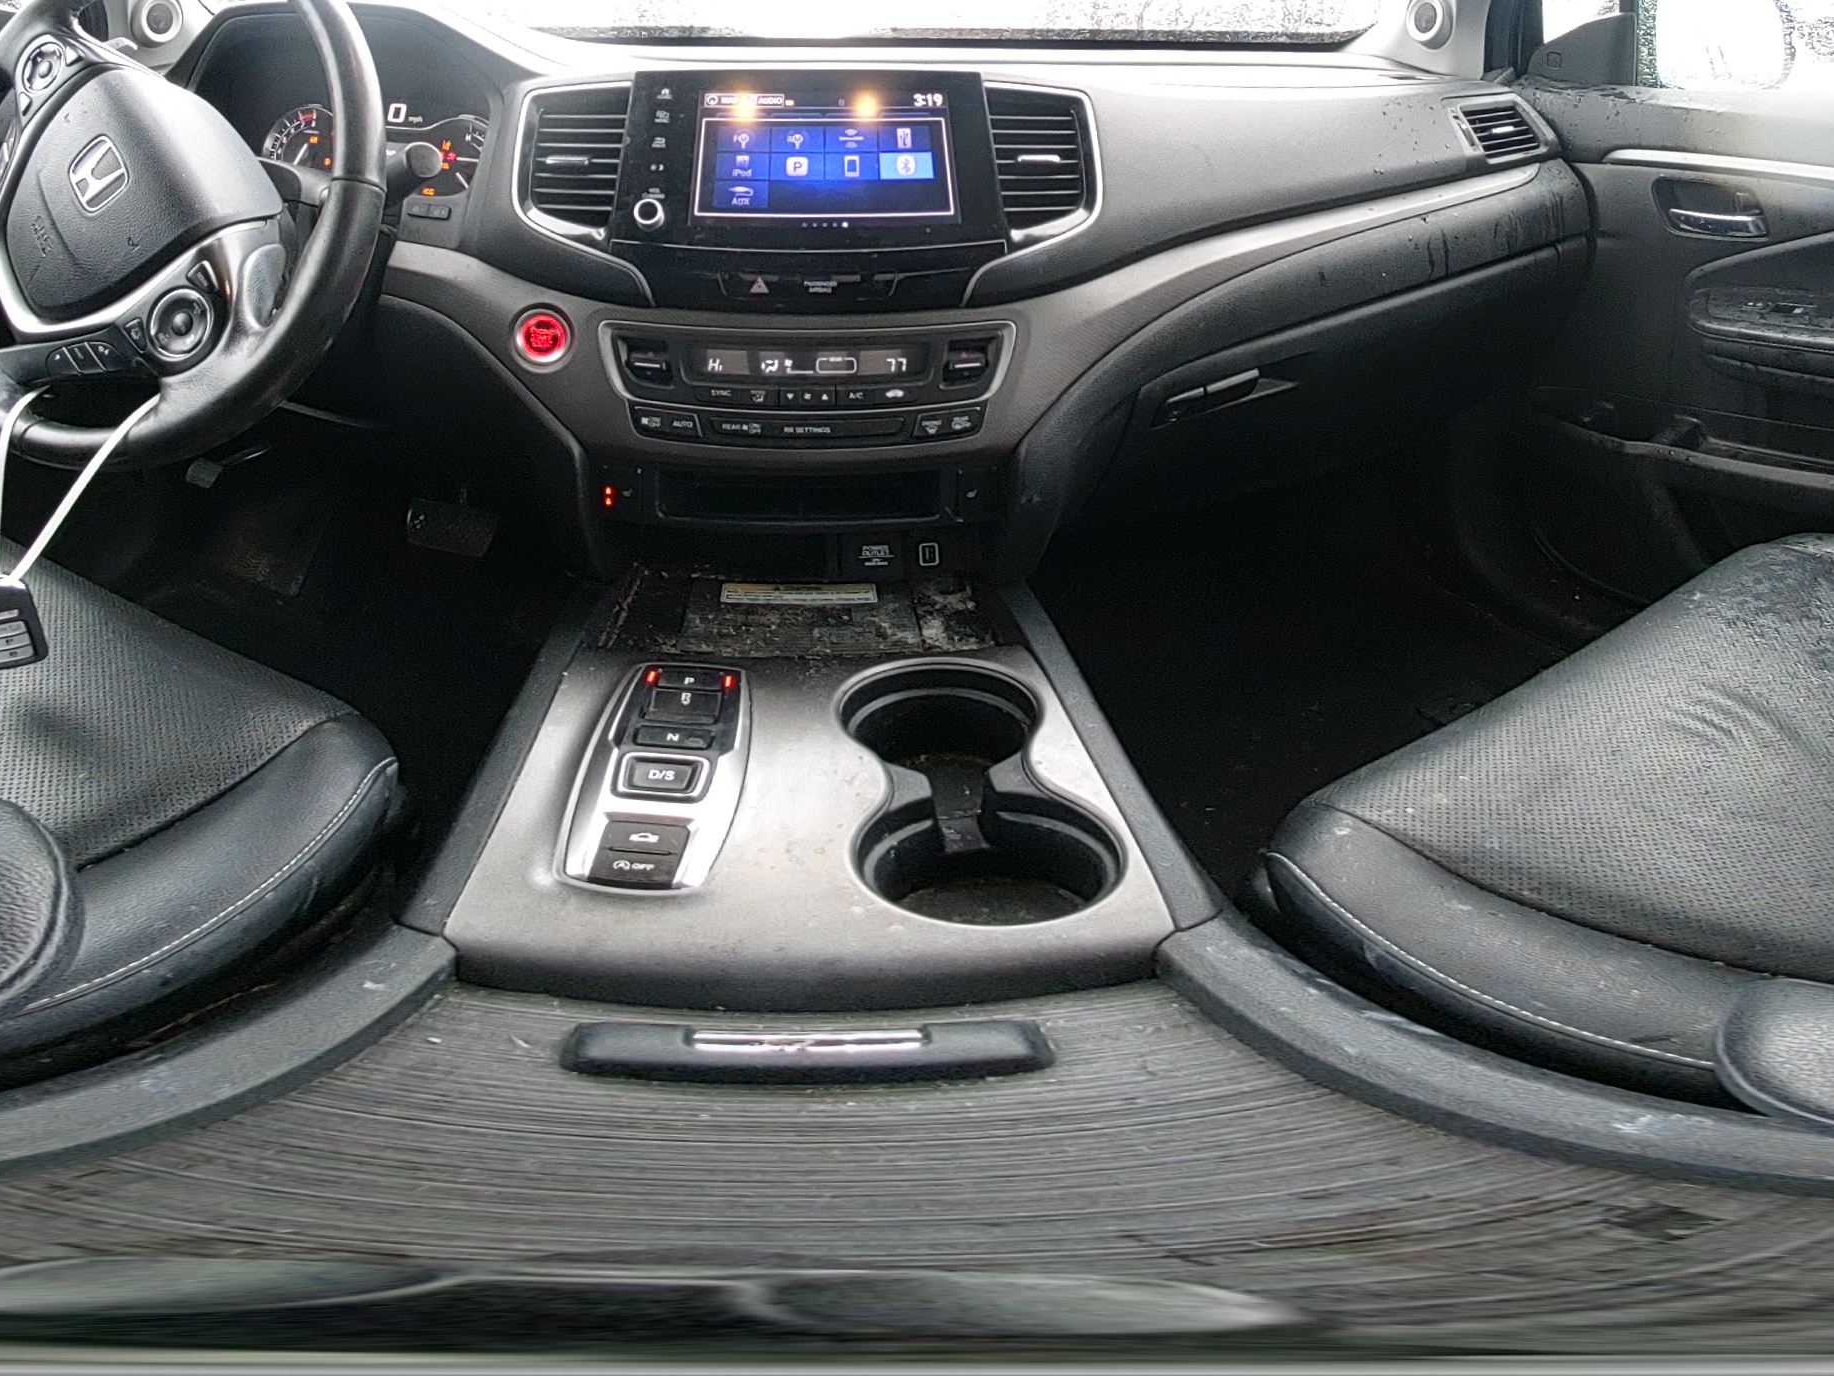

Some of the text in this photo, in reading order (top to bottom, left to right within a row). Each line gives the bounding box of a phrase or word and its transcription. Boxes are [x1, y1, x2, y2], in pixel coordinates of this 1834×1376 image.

[758, 97, 783, 105] AUDIO
[913, 93, 943, 107] 3:19
[732, 168, 752, 177] iPod
[886, 358, 907, 372] 77
[711, 389, 731, 397] SYNC
[672, 420, 693, 428] AUTO
[684, 676, 695, 685] P
[666, 733, 680, 741] N
[648, 769, 675, 781] D/S
